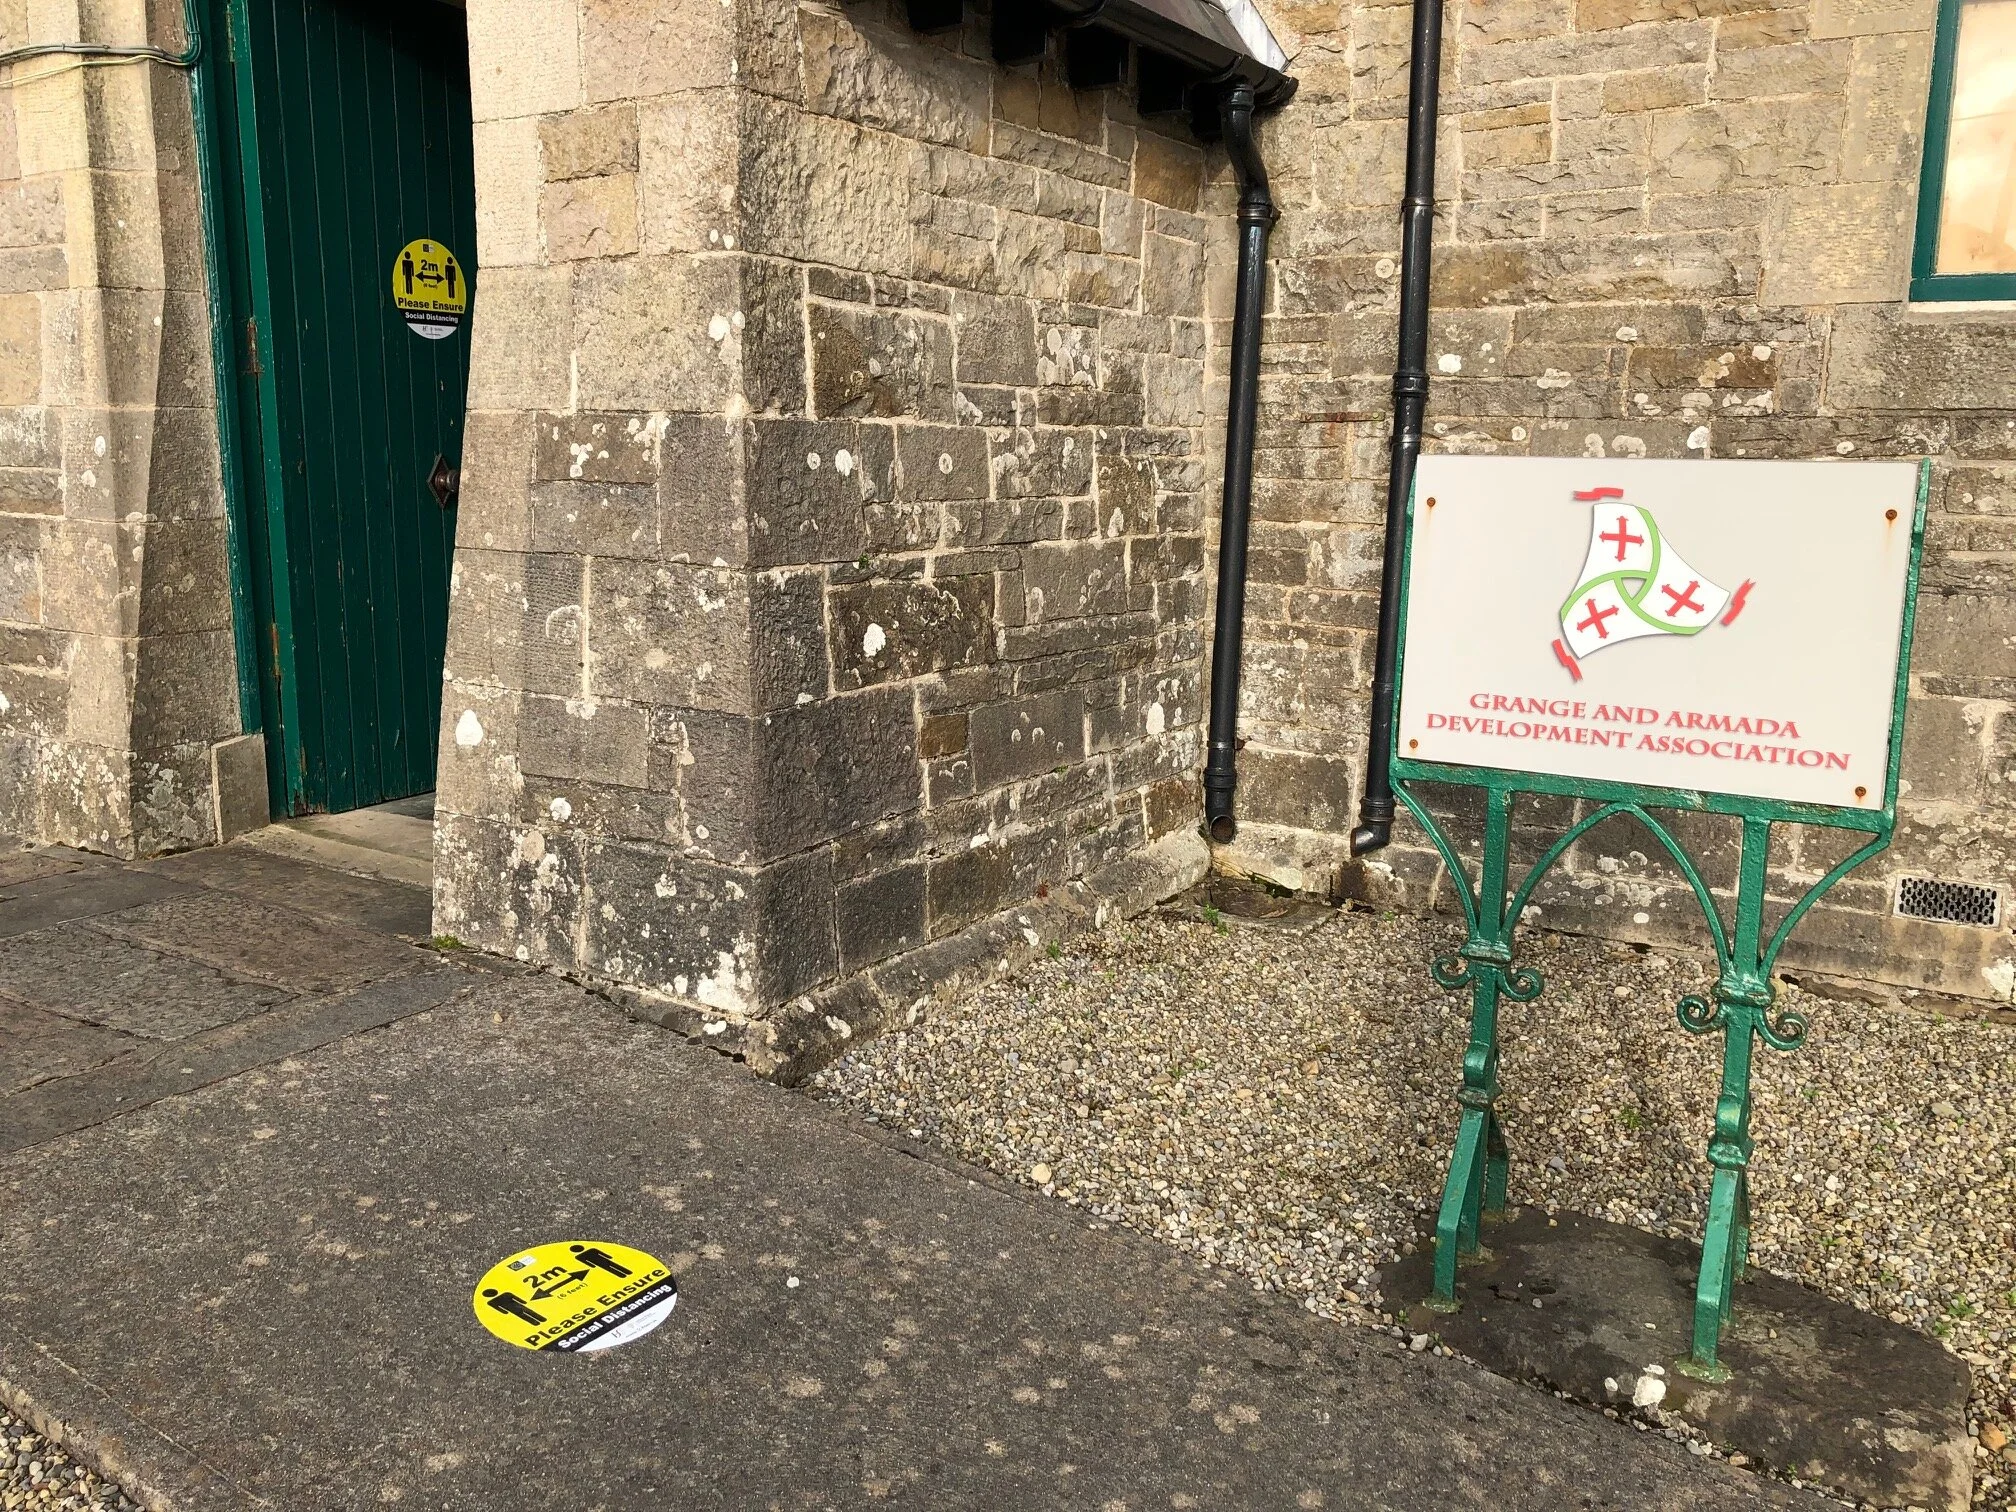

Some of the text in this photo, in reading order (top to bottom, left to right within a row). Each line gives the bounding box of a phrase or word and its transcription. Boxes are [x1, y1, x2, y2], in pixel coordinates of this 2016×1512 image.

[421, 259, 438, 272] 2m
[398, 297, 463, 312] Please Ensure
[405, 312, 459, 324] Social Distancing
[1470, 693, 1801, 739] GRANGE AND ARMADA
[1427, 713, 1851, 771] DEVELOPMENT ASSOCIATION
[523, 1264, 568, 1289] 2m
[524, 1306, 598, 1347] Please
[597, 1269, 666, 1307] Ensure
[557, 1321, 601, 1349] Social
[600, 1285, 673, 1324] Distancing
